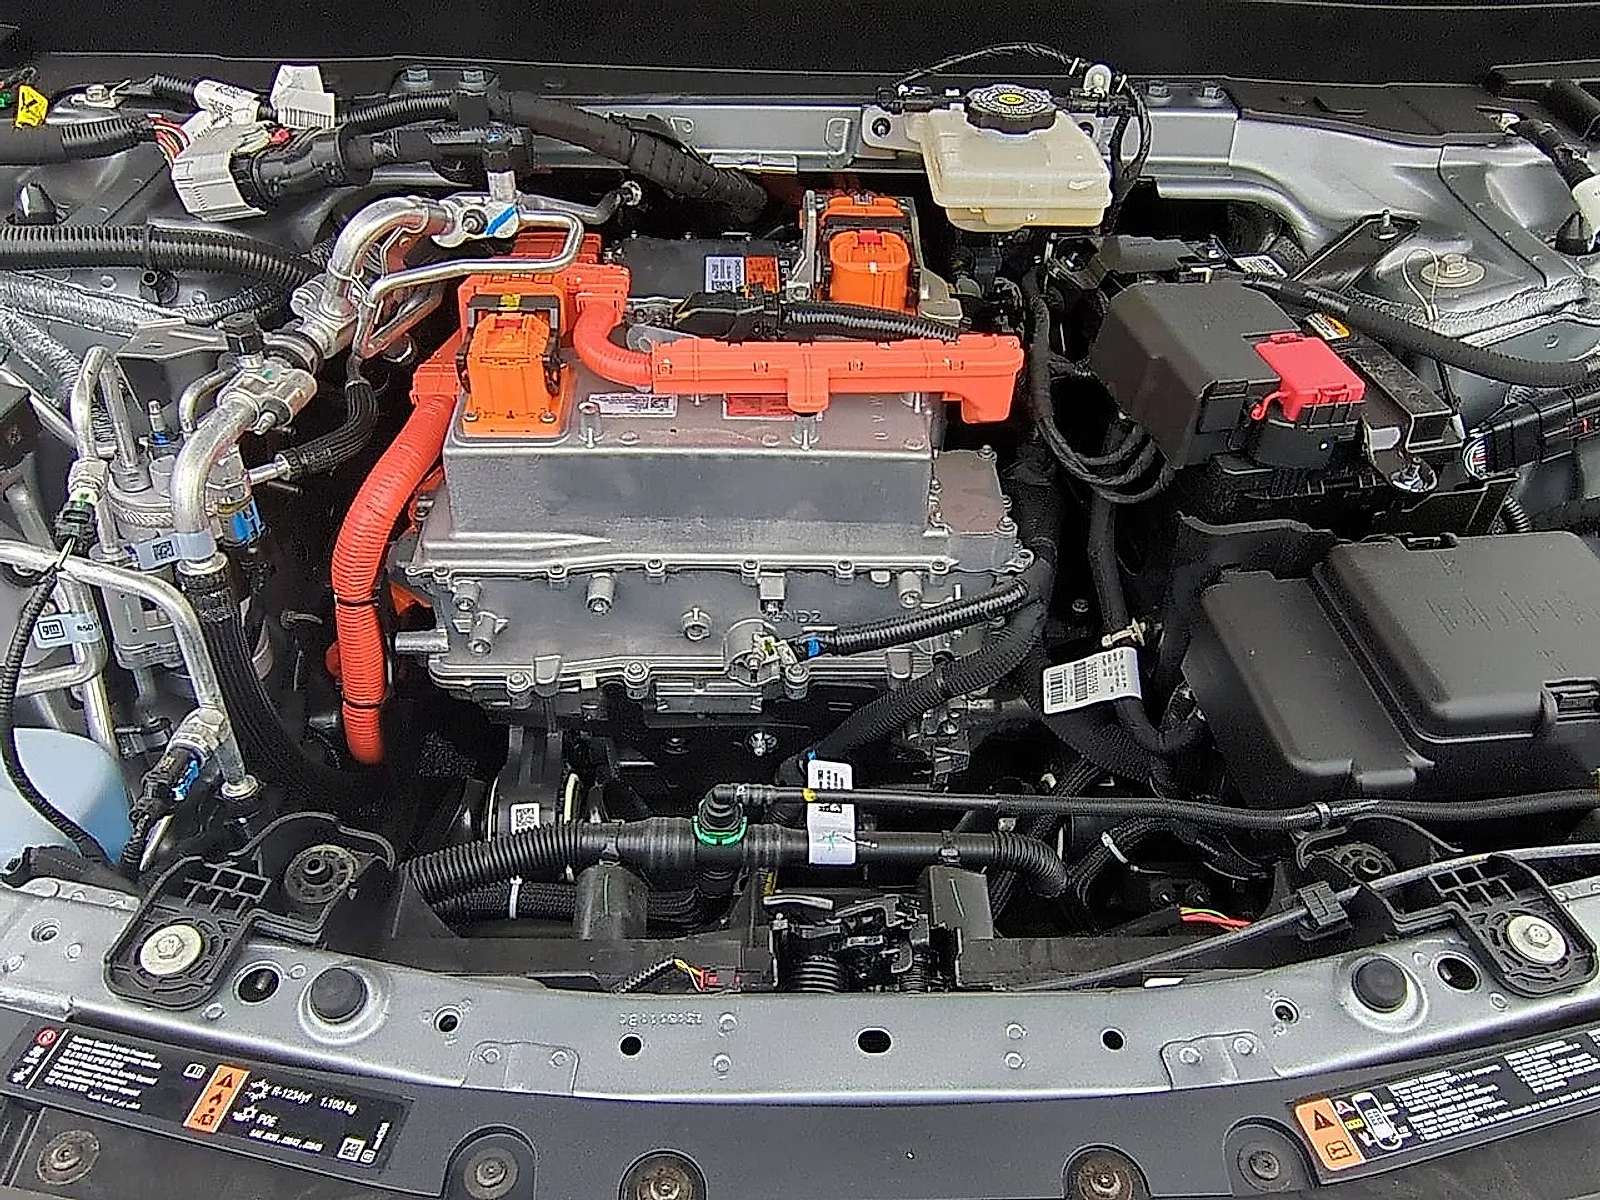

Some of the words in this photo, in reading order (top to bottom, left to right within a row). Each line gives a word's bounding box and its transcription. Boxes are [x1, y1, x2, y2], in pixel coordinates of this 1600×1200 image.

[271, 1086, 313, 1104] R-1234yf
[344, 1102, 358, 1116] kg
[257, 1113, 278, 1128] POE
